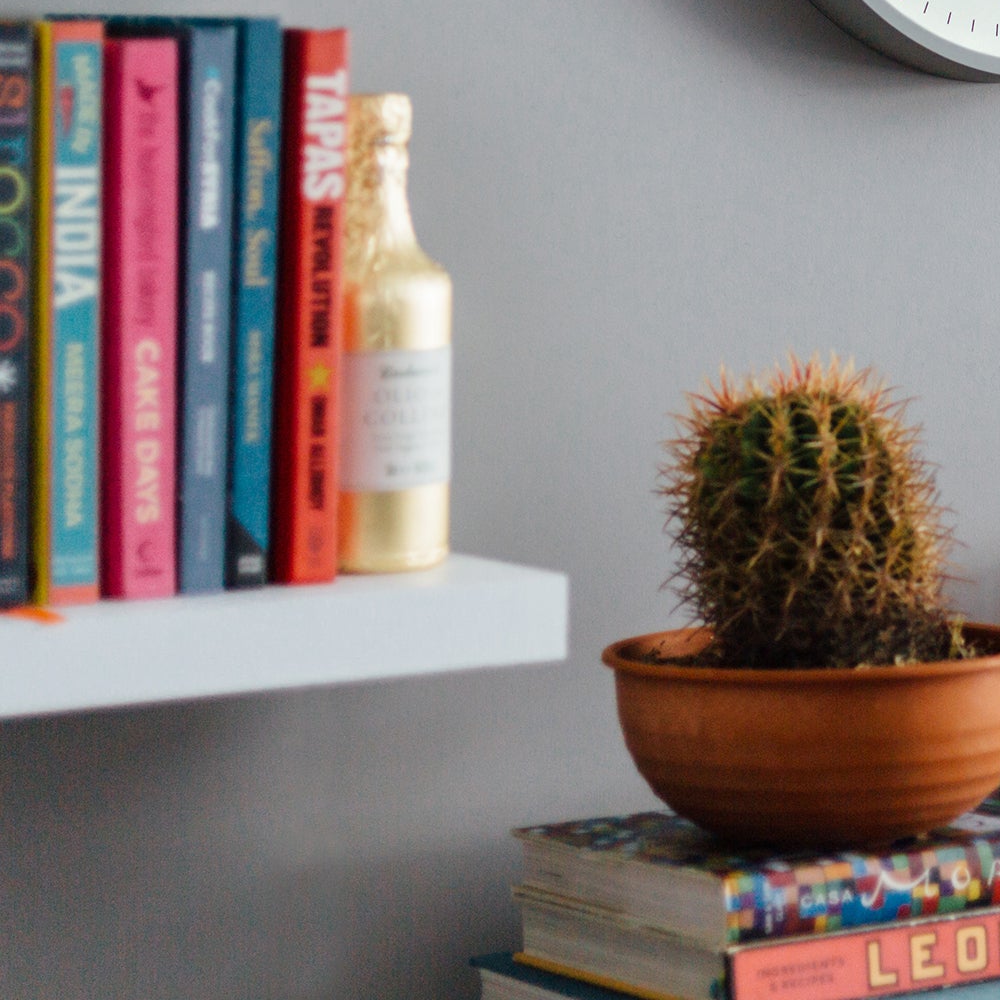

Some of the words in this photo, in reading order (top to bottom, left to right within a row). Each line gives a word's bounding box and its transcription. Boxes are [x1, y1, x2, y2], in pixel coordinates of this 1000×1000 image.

[304, 69, 346, 202] TAPAS
[53, 166, 98, 308] INDIA
[310, 204, 334, 347] REVOLUTION
[134, 339, 161, 432] CAKE
[134, 441, 160, 525] DAYS
[800, 887, 854, 910] CASA
